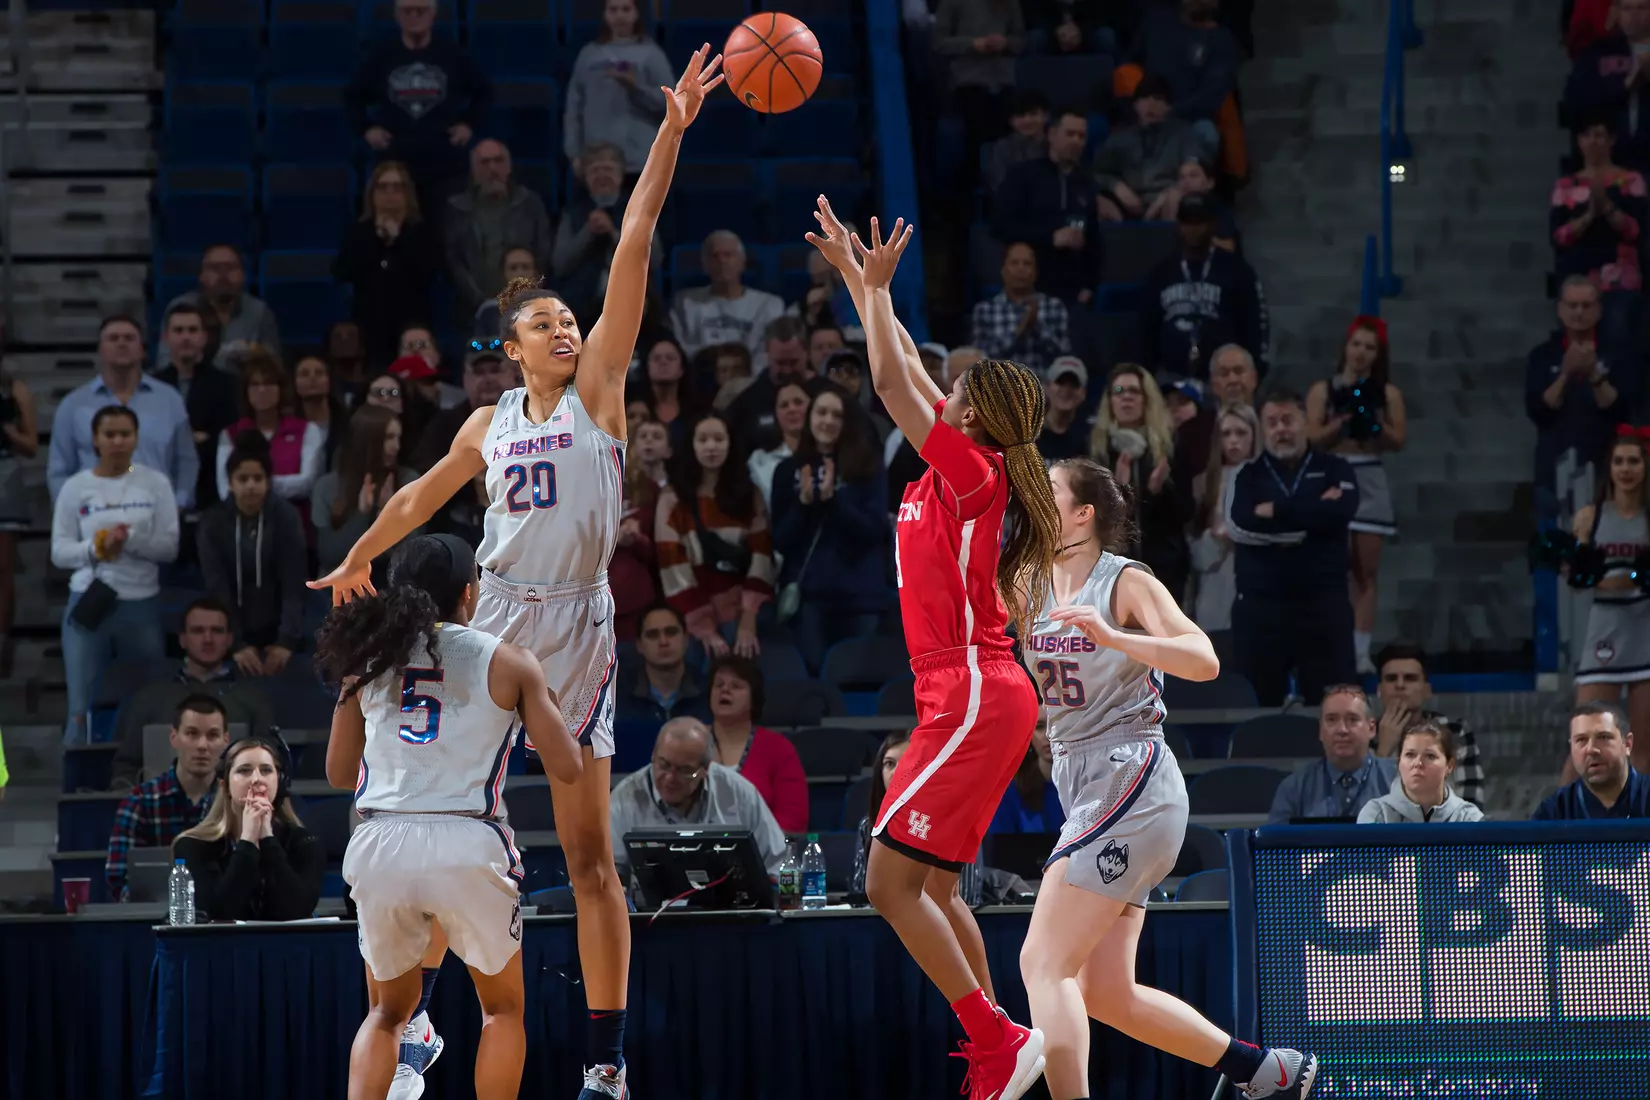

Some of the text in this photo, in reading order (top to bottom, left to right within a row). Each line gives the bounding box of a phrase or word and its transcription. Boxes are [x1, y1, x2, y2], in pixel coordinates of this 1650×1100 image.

[492, 432, 573, 462] HUSKIES
[504, 460, 558, 513] 20
[1026, 634, 1096, 653] HUSKIES
[397, 667, 444, 745] 5
[1037, 660, 1086, 707] 25
[907, 809, 932, 841] UH
[1302, 849, 1637, 955] CBS
